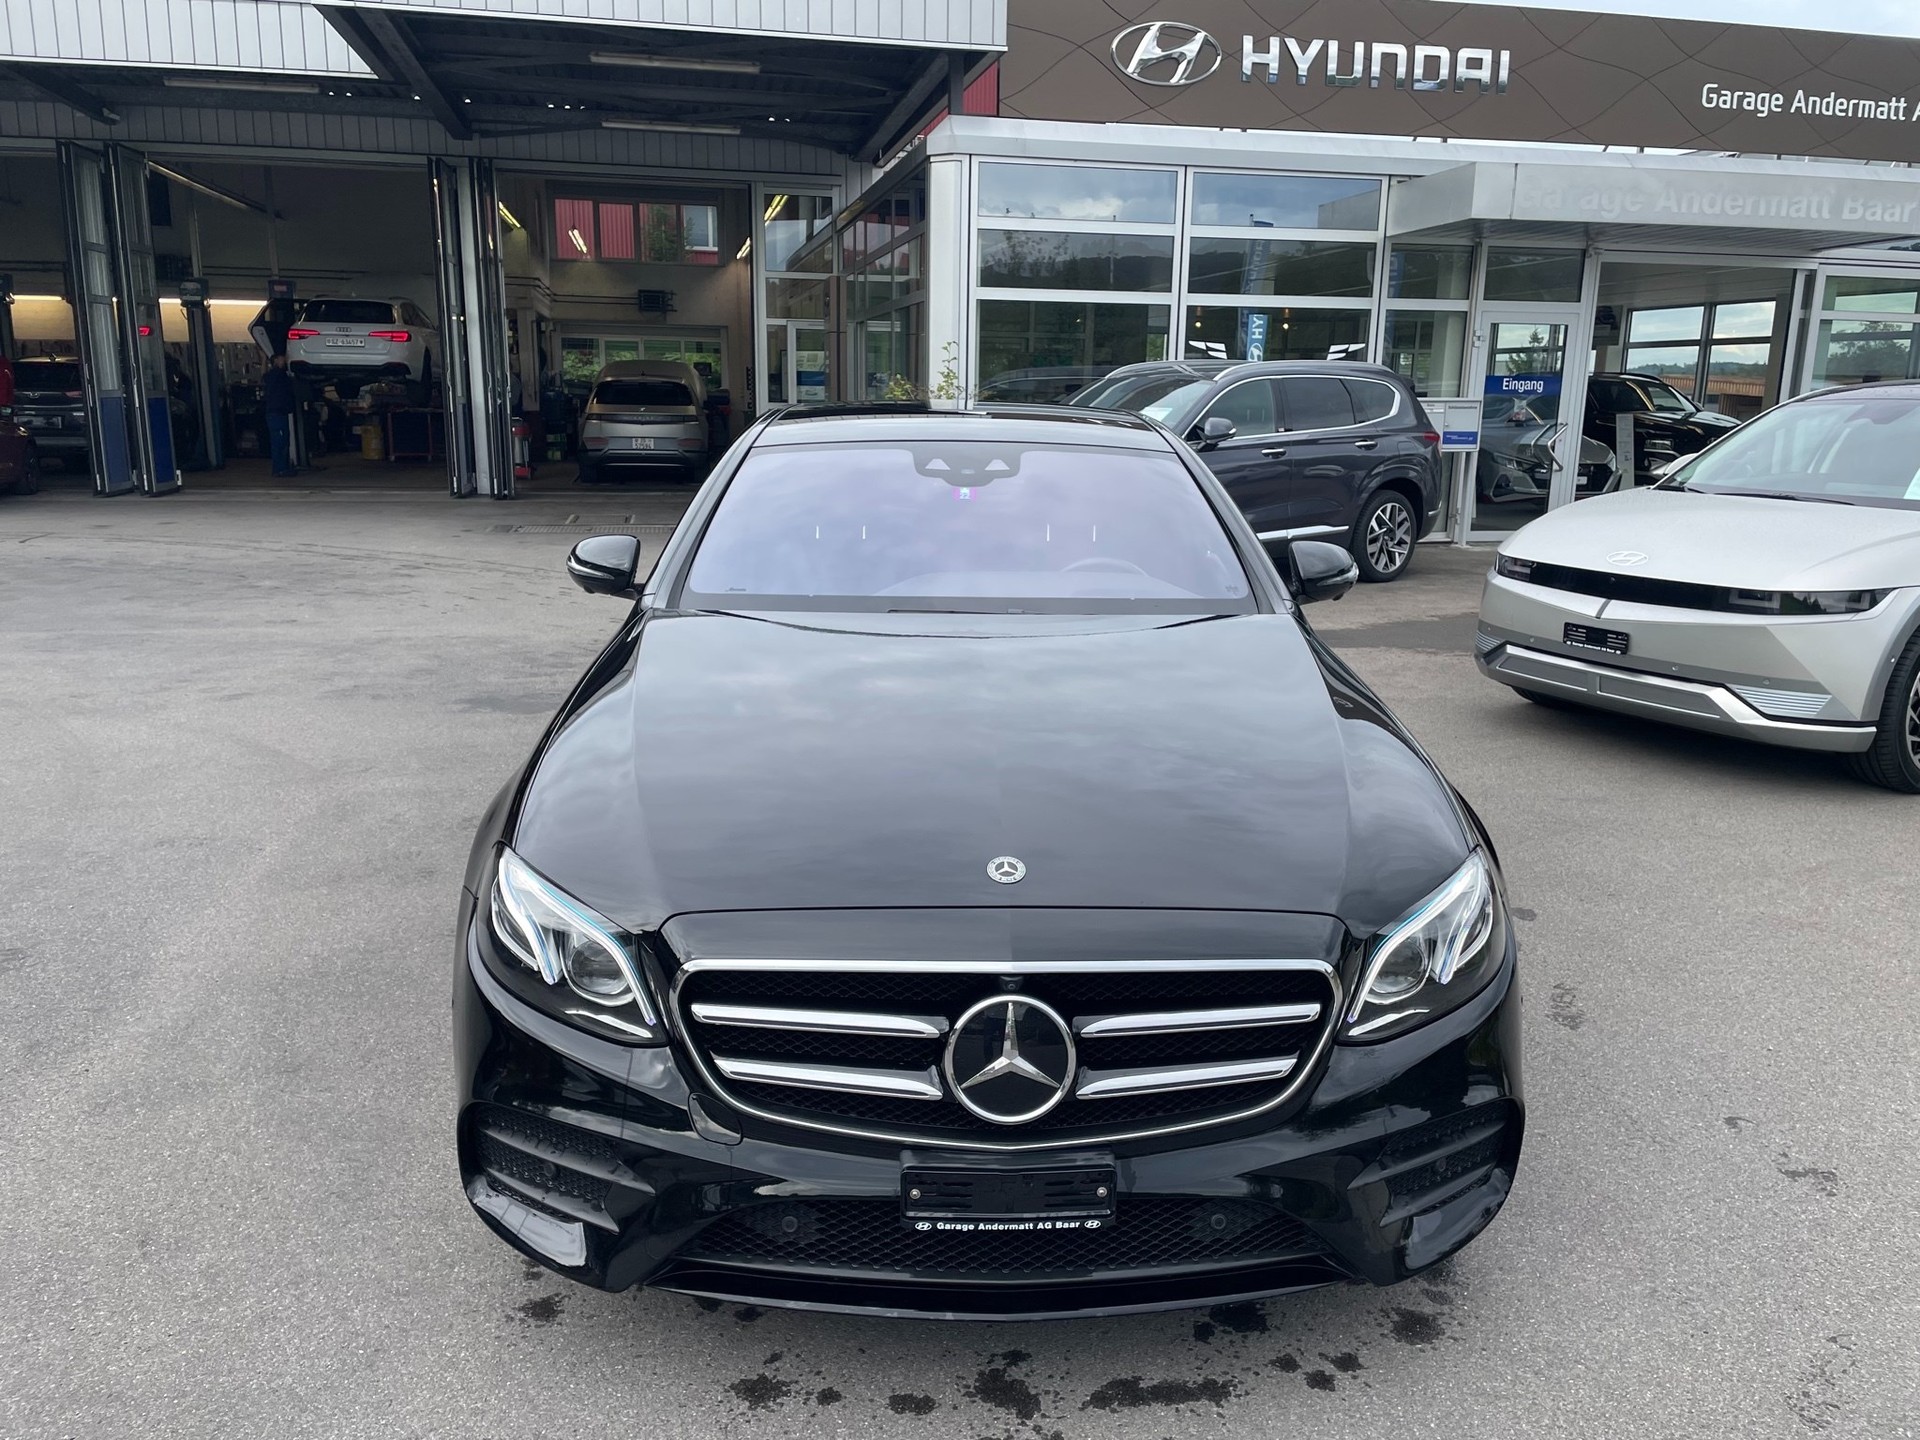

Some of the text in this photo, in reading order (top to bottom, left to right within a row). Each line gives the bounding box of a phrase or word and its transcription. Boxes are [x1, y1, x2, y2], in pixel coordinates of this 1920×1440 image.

[1240, 34, 1511, 95] HYUNDAI
[1701, 83, 1784, 117] Garage
[1789, 89, 1907, 121] Andermatt
[1502, 377, 1544, 393] Eingang
[937, 1221, 1081, 1232] Garage Andermatt AG Baar
